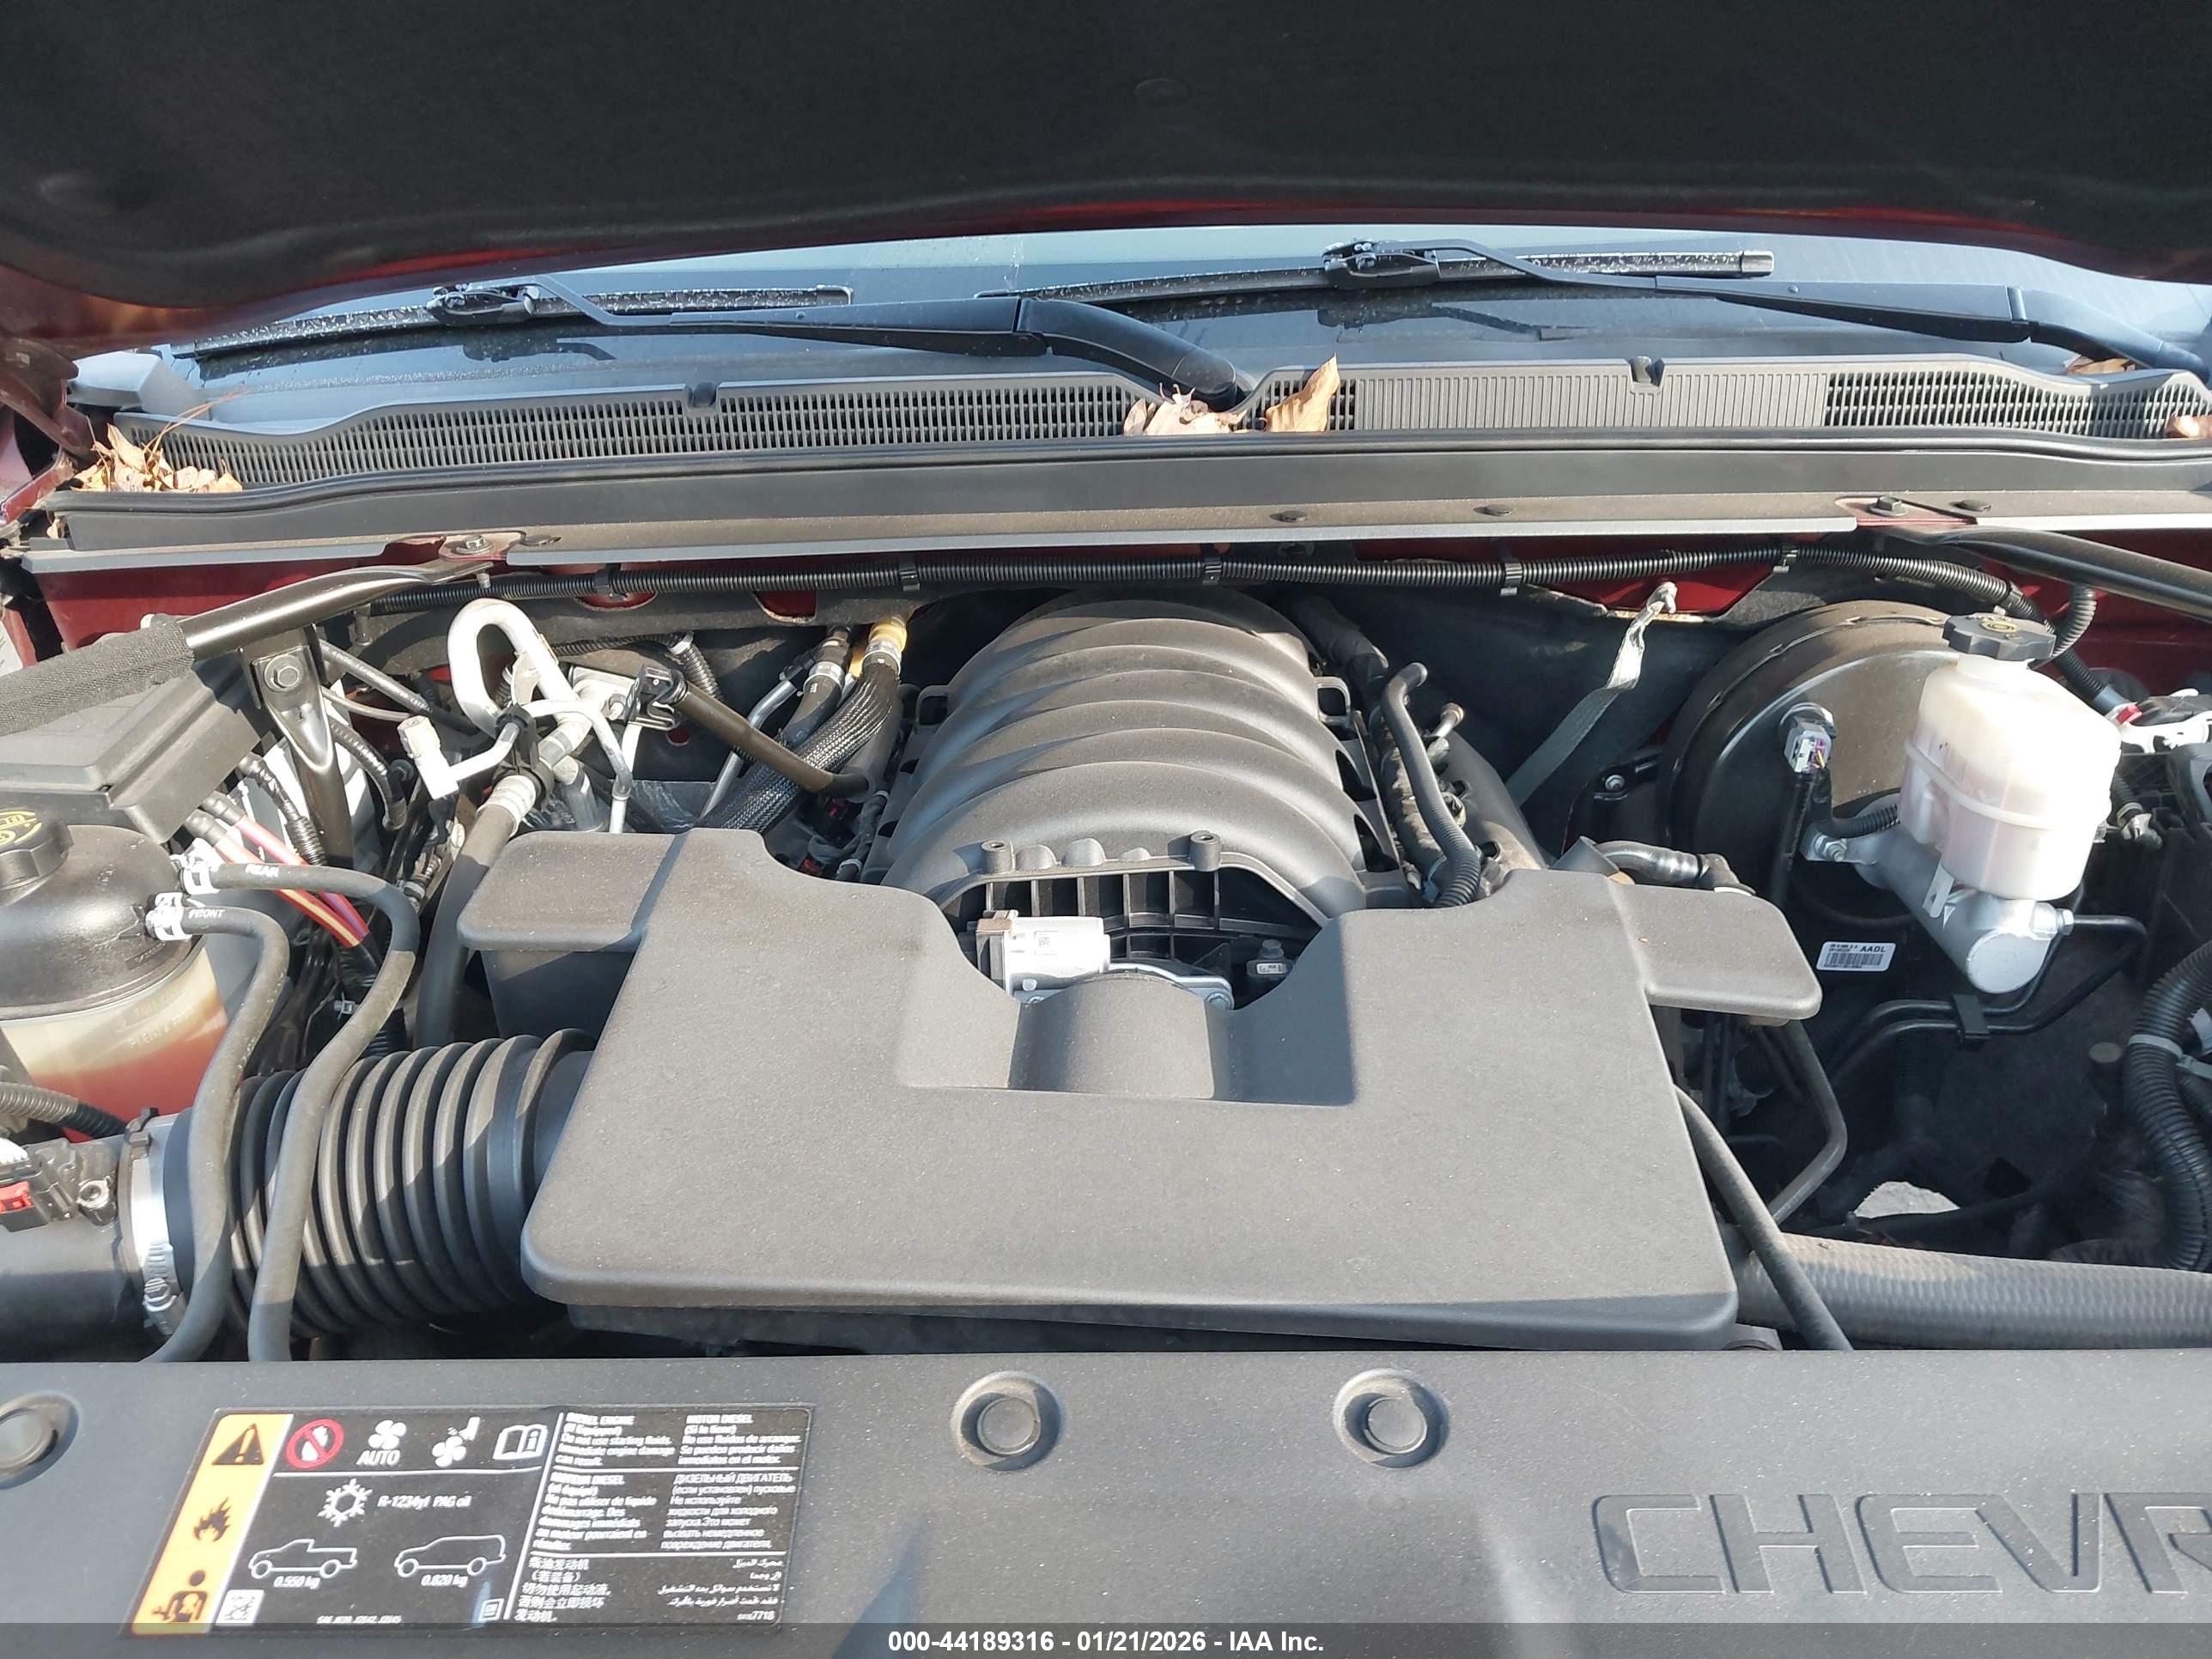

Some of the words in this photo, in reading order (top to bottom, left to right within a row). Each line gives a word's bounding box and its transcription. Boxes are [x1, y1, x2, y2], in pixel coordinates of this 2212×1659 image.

[245, 863, 279, 878] REAR
[188, 908, 226, 919] FRONT
[355, 1449, 401, 1466] AUTO
[1591, 1492, 2212, 1595] CHEVR
[304, 1575, 320, 1589] kg
[453, 1574, 468, 1588] kg
